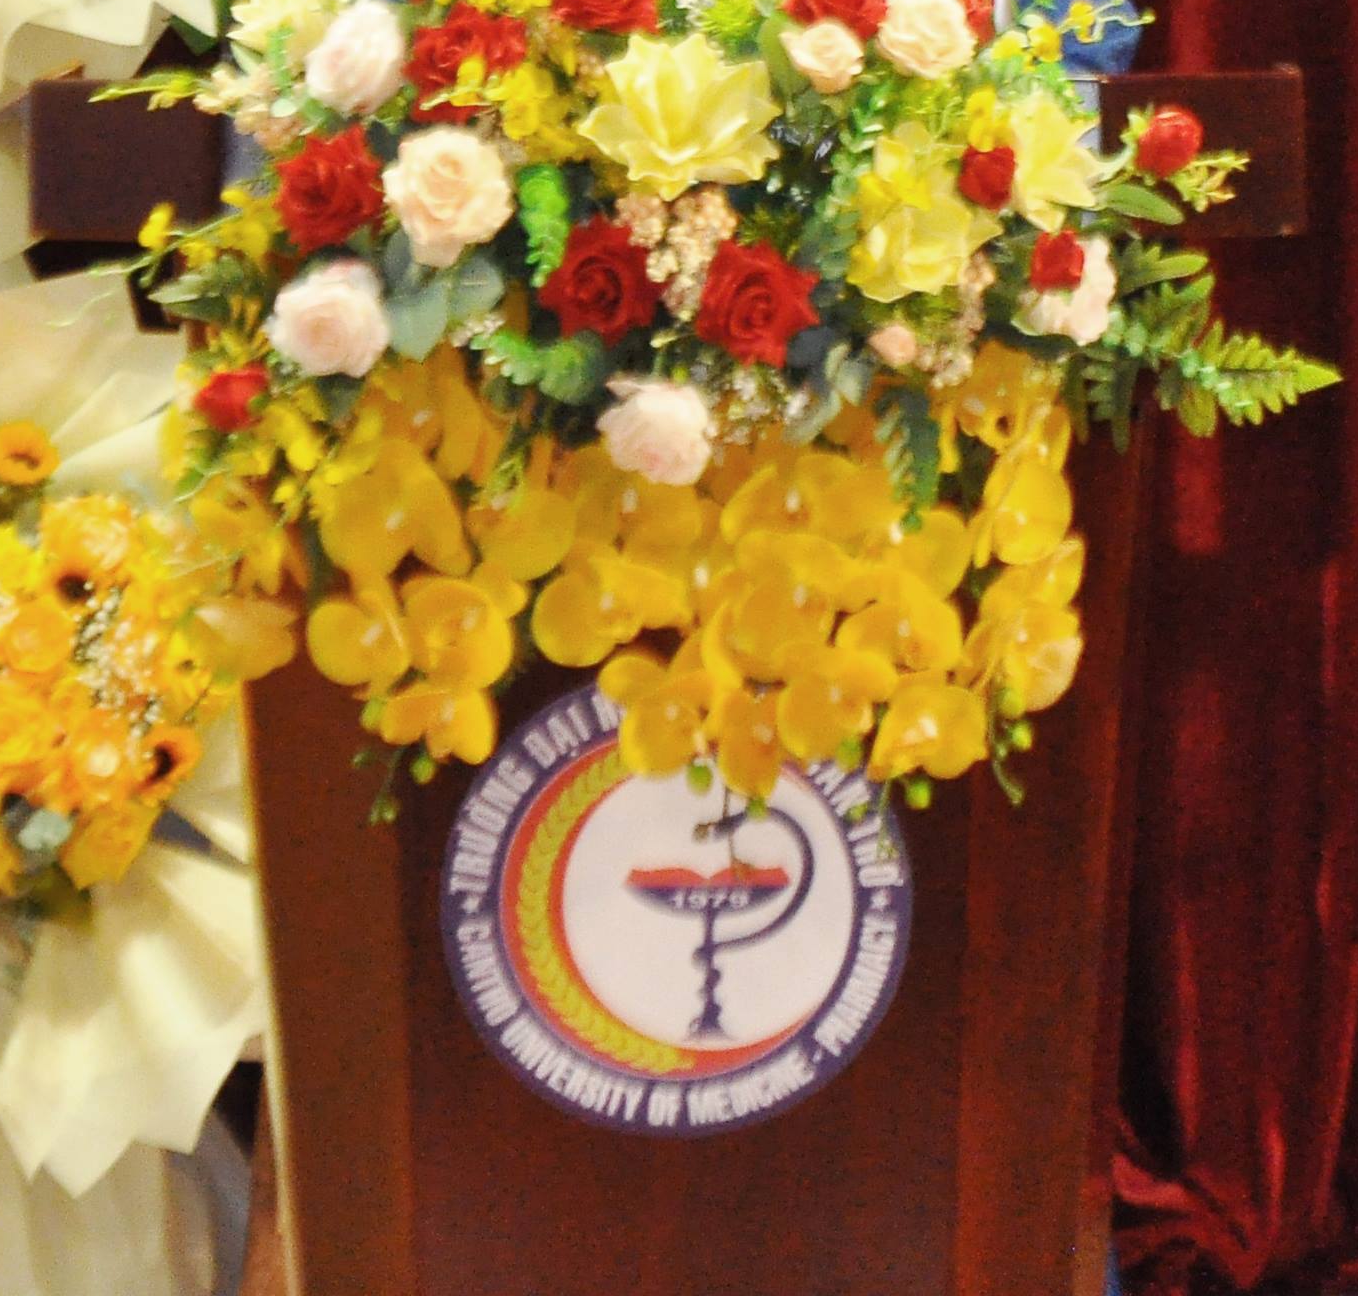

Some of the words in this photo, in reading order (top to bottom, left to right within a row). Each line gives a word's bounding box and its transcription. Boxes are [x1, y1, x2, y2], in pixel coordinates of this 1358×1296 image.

[500, 1013, 644, 1122] UNIVERSITY
[646, 1080, 681, 1127] OF
[686, 1043, 816, 1127] MEDICINE
[814, 913, 898, 1058] PHARMACY
